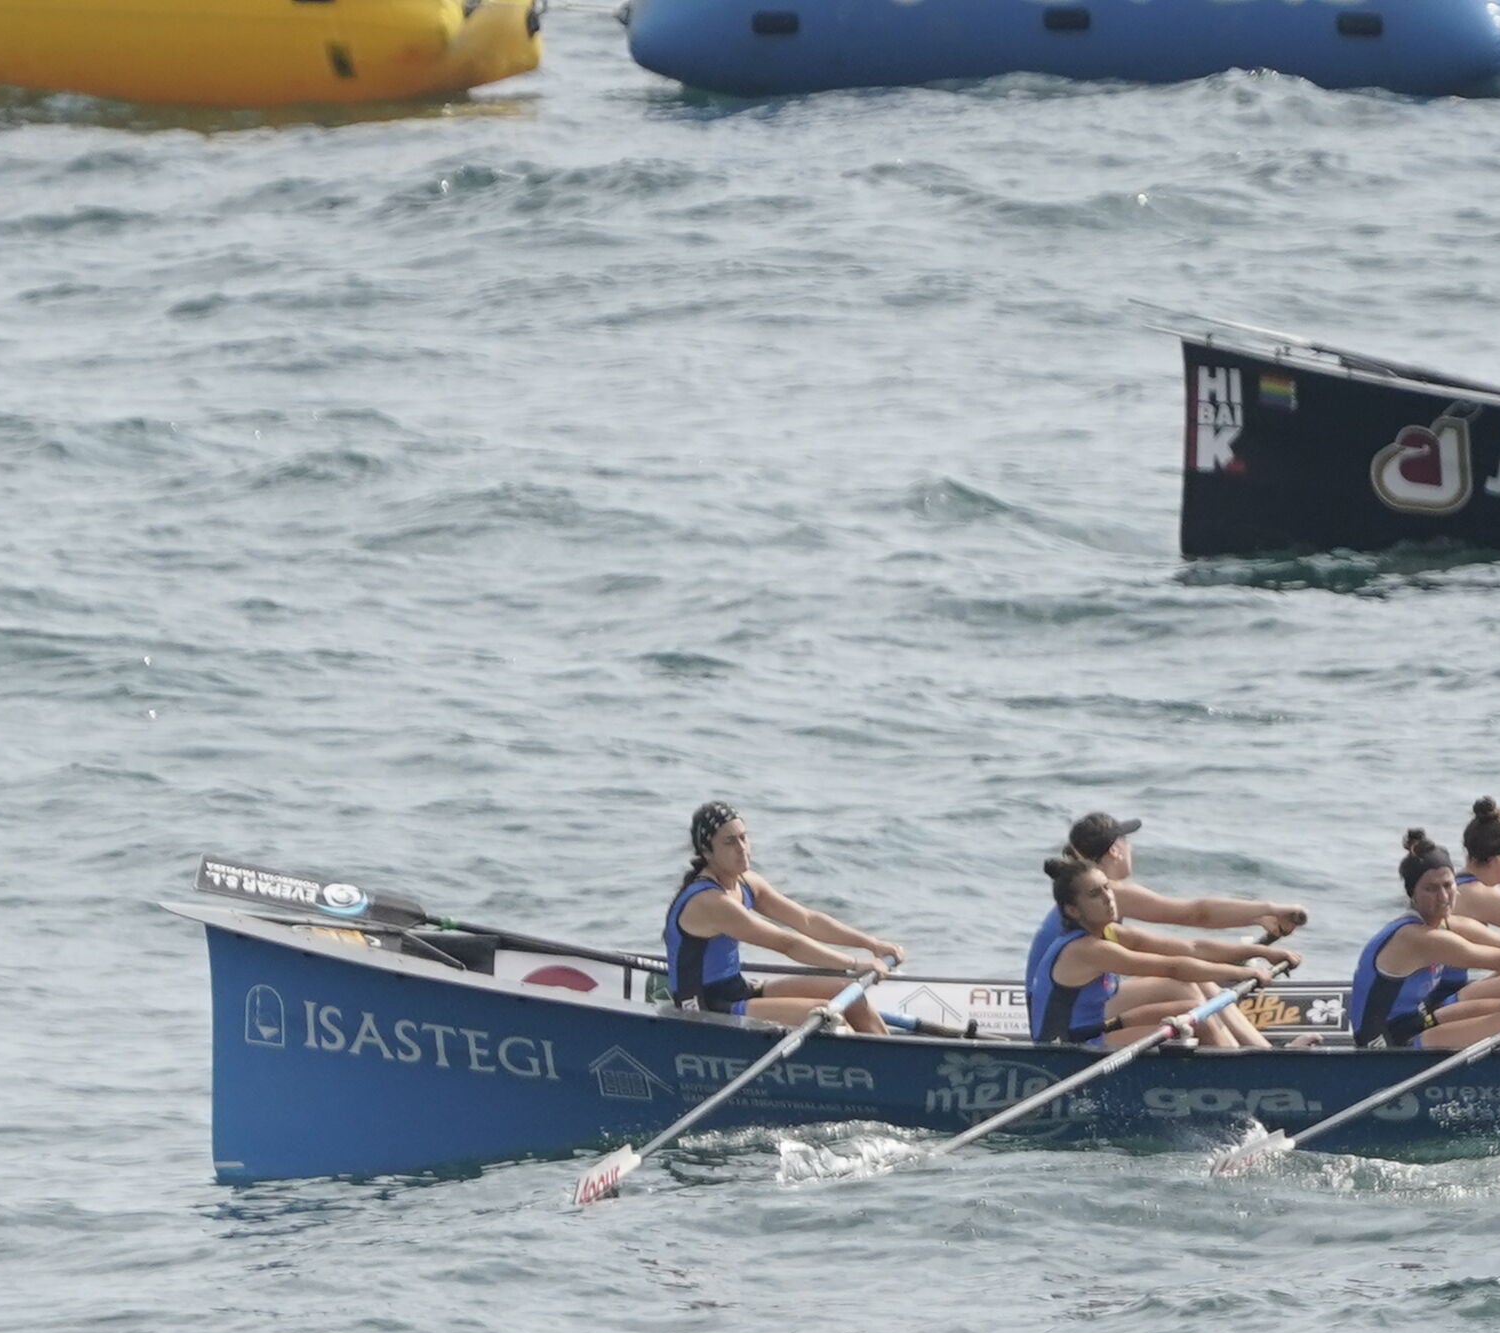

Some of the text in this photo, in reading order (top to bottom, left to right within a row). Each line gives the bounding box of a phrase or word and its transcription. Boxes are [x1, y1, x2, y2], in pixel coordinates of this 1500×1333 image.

[1197, 365, 1242, 404] HI
[302, 998, 561, 1081] ISASTEGI
[674, 1053, 875, 1092] ATERPEA
